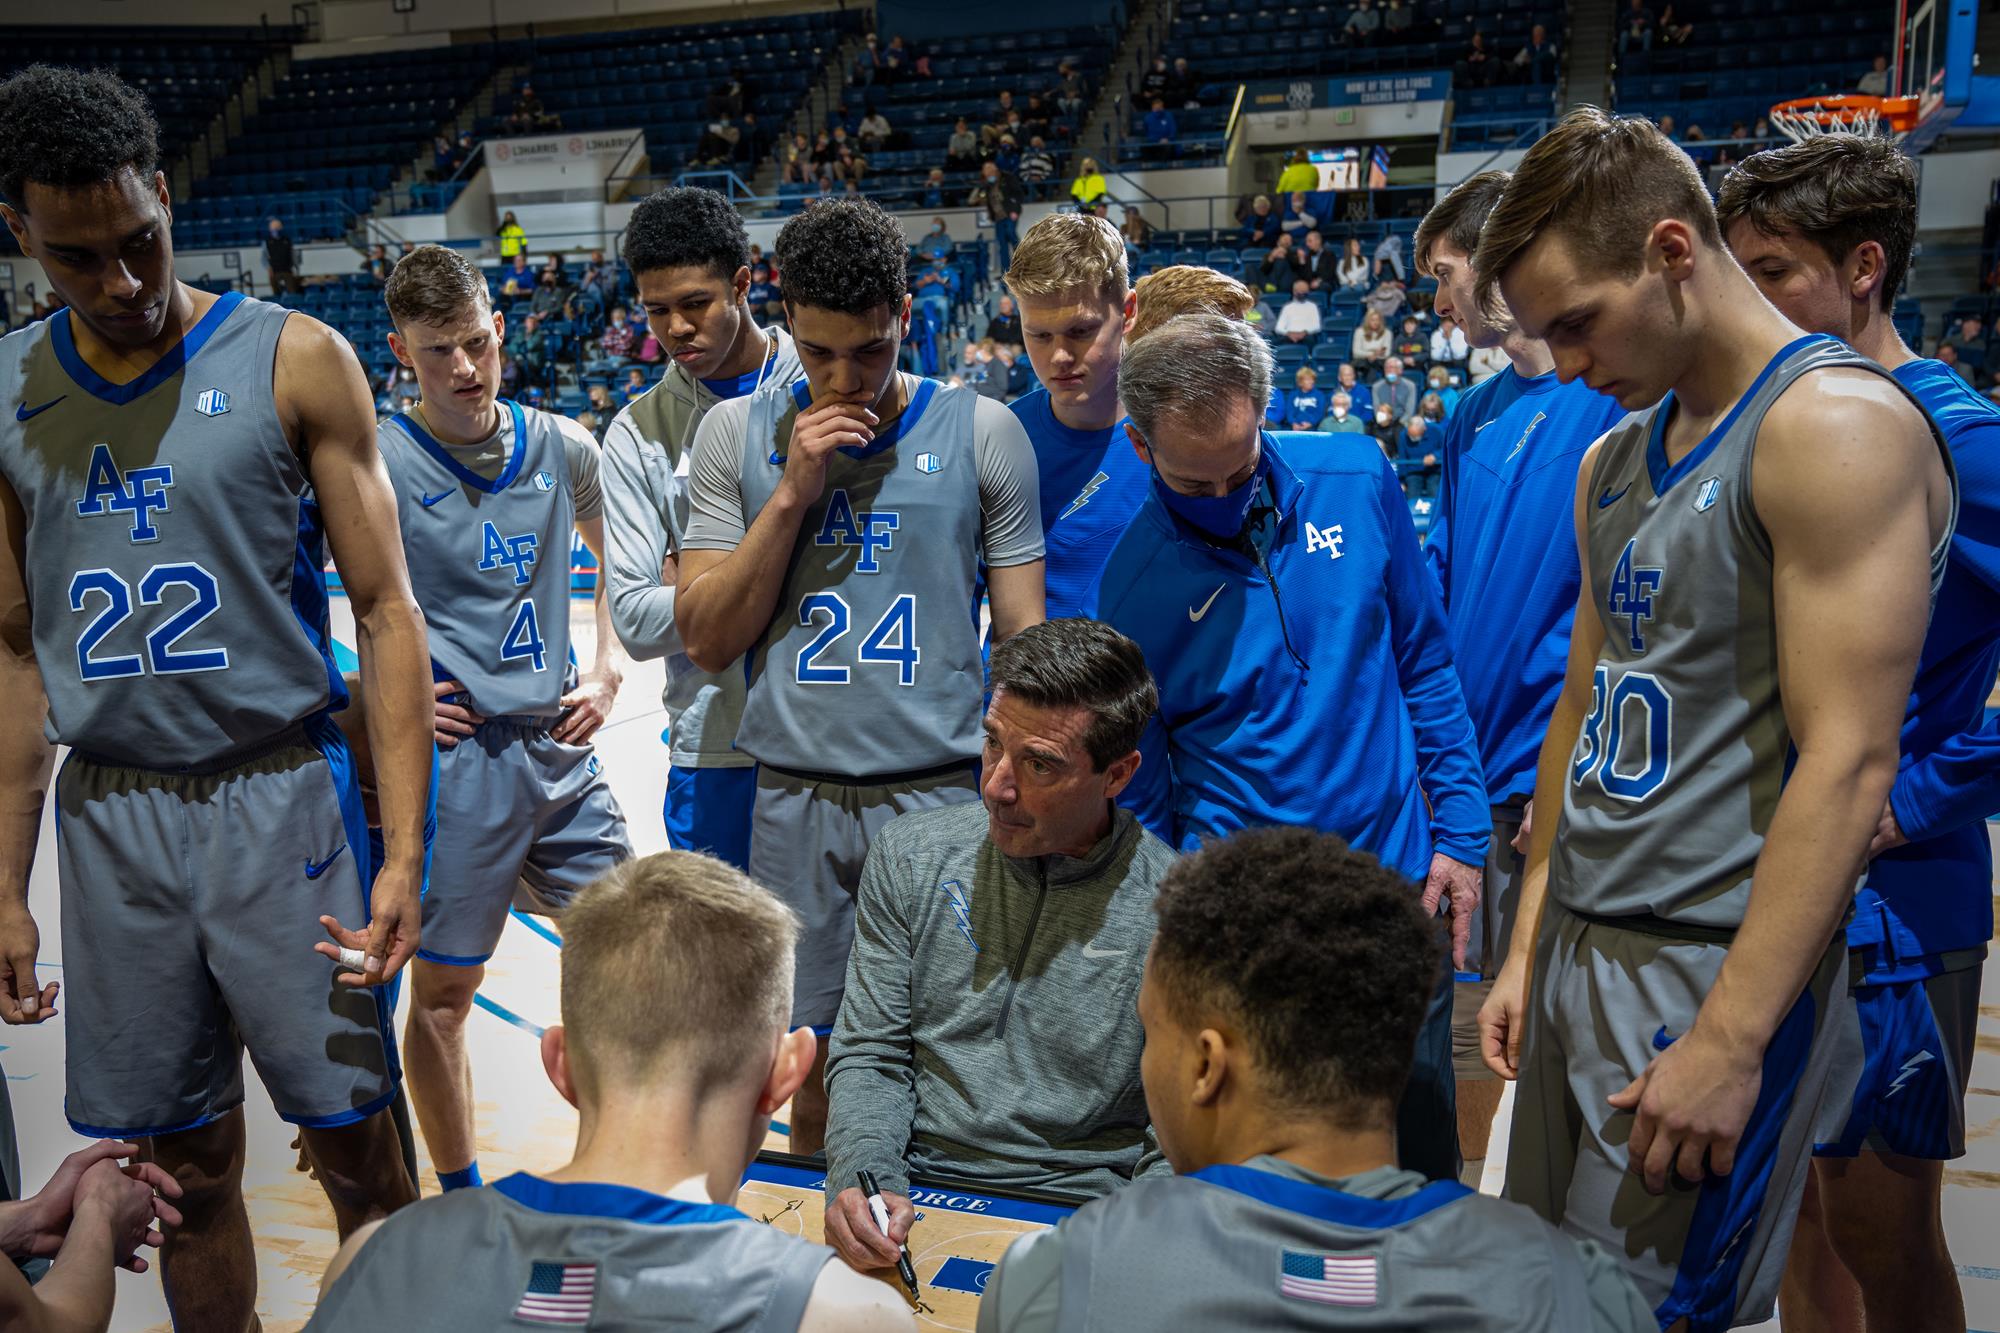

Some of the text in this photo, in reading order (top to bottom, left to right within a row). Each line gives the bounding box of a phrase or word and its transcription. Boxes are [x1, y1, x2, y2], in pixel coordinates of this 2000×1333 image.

[76, 443, 174, 543] AF
[815, 489, 899, 573] AF
[478, 520, 538, 586] AF
[1304, 521, 1345, 560] AF
[68, 561, 230, 682] 22
[501, 598, 547, 673] 4
[1608, 537, 1664, 653] AF
[796, 592, 920, 686] 24
[908, 1190, 992, 1212] ORCE
